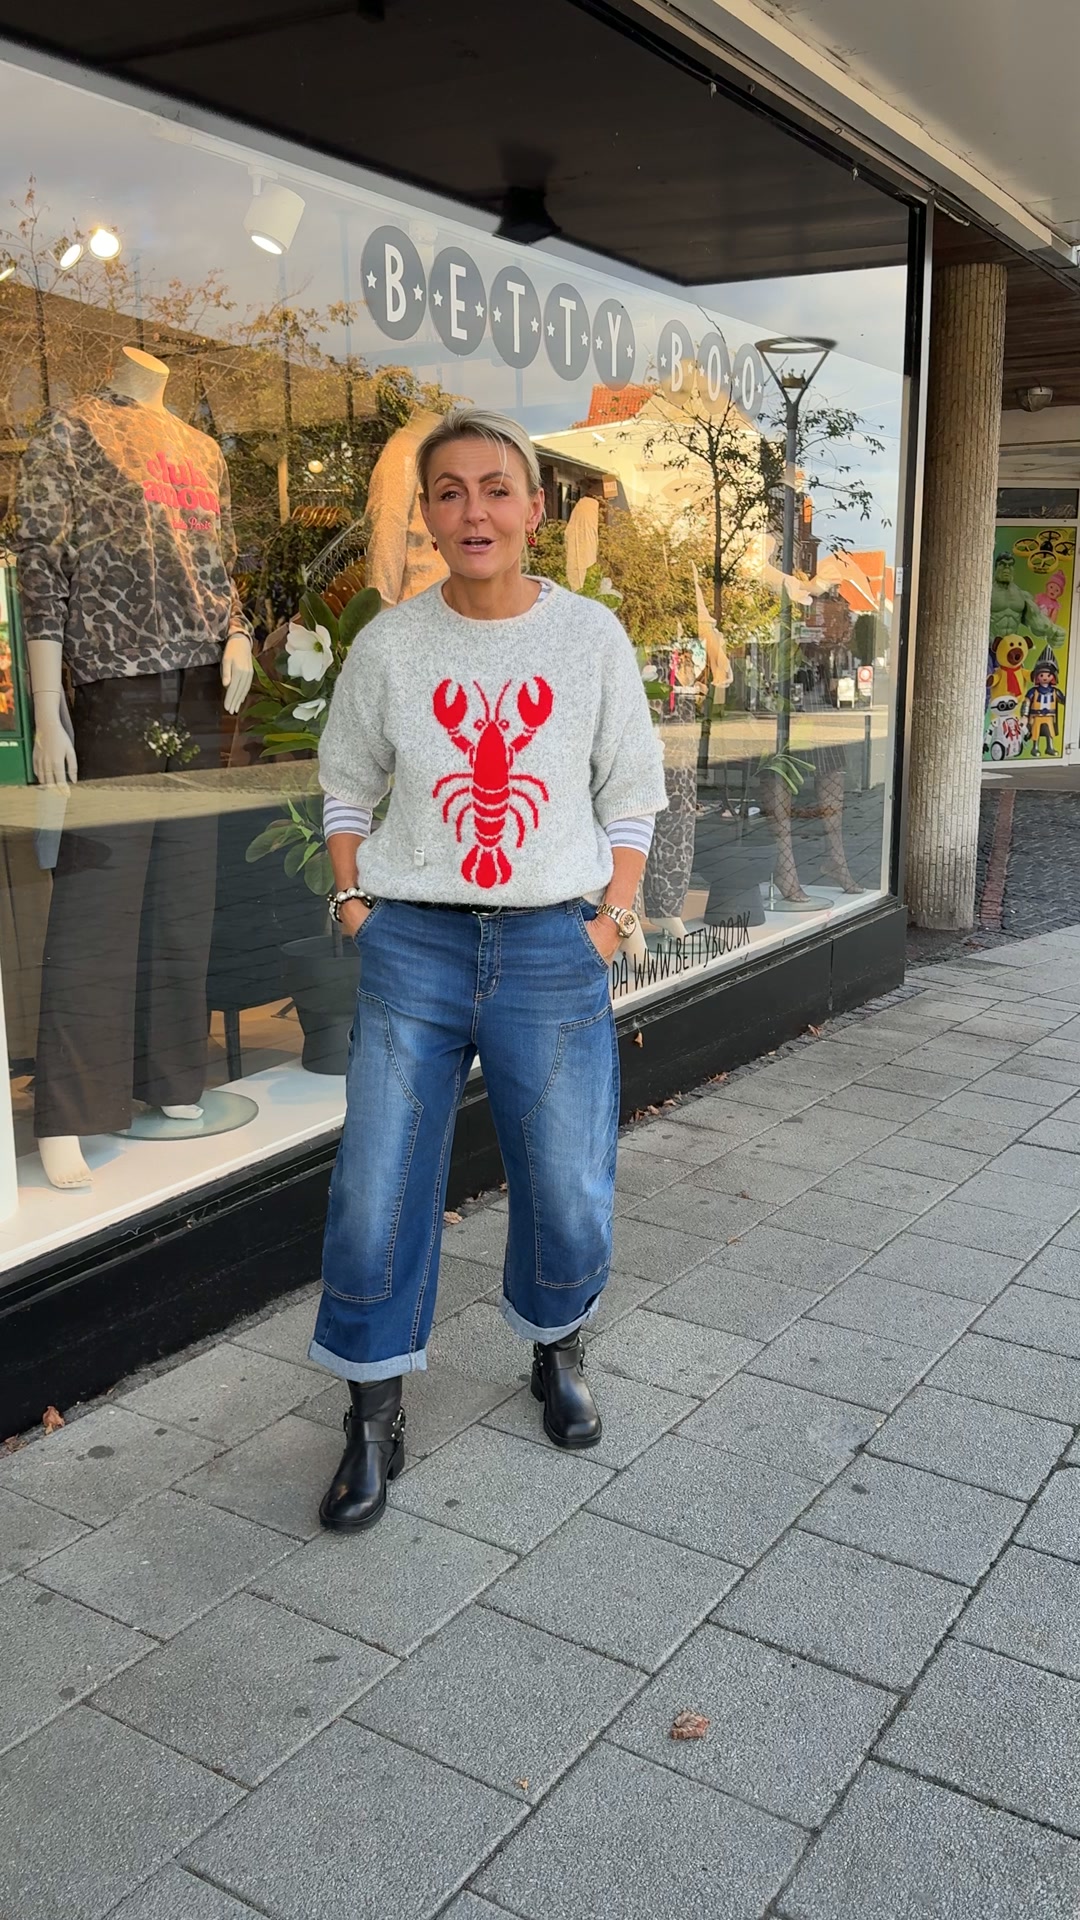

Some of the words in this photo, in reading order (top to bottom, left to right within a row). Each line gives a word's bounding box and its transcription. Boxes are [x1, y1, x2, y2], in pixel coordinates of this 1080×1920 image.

[385, 243, 623, 378] BETTY
[670, 331, 755, 411] BOO
[146, 451, 208, 488] club
[142, 480, 220, 515] amou
[188, 516, 211, 530] Paris
[612, 951, 629, 999] PÅ
[634, 911, 751, 990] WWW.BETTYBOO.DK
